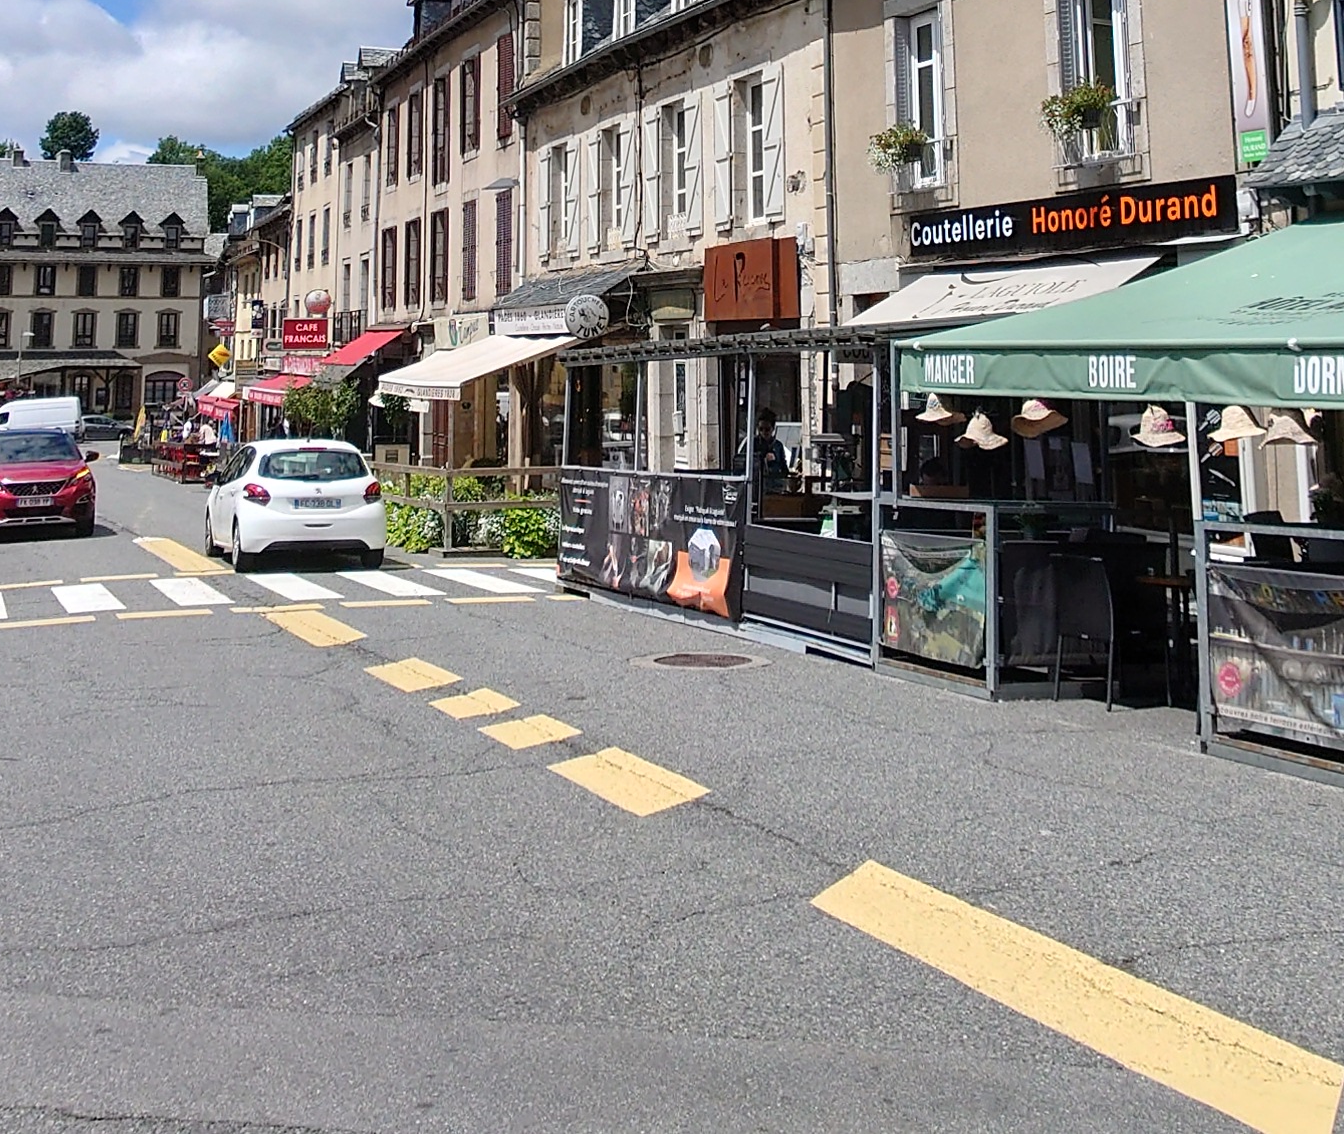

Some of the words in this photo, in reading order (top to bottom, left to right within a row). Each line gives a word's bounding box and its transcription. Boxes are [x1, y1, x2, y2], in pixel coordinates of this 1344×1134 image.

[910, 210, 1014, 247] Coutellerie
[1031, 195, 1112, 235] Honoré
[1119, 184, 1218, 225] Durand
[576, 314, 607, 340] TUNET
[923, 354, 975, 385] MANGER
[1088, 355, 1137, 389] BOIRE
